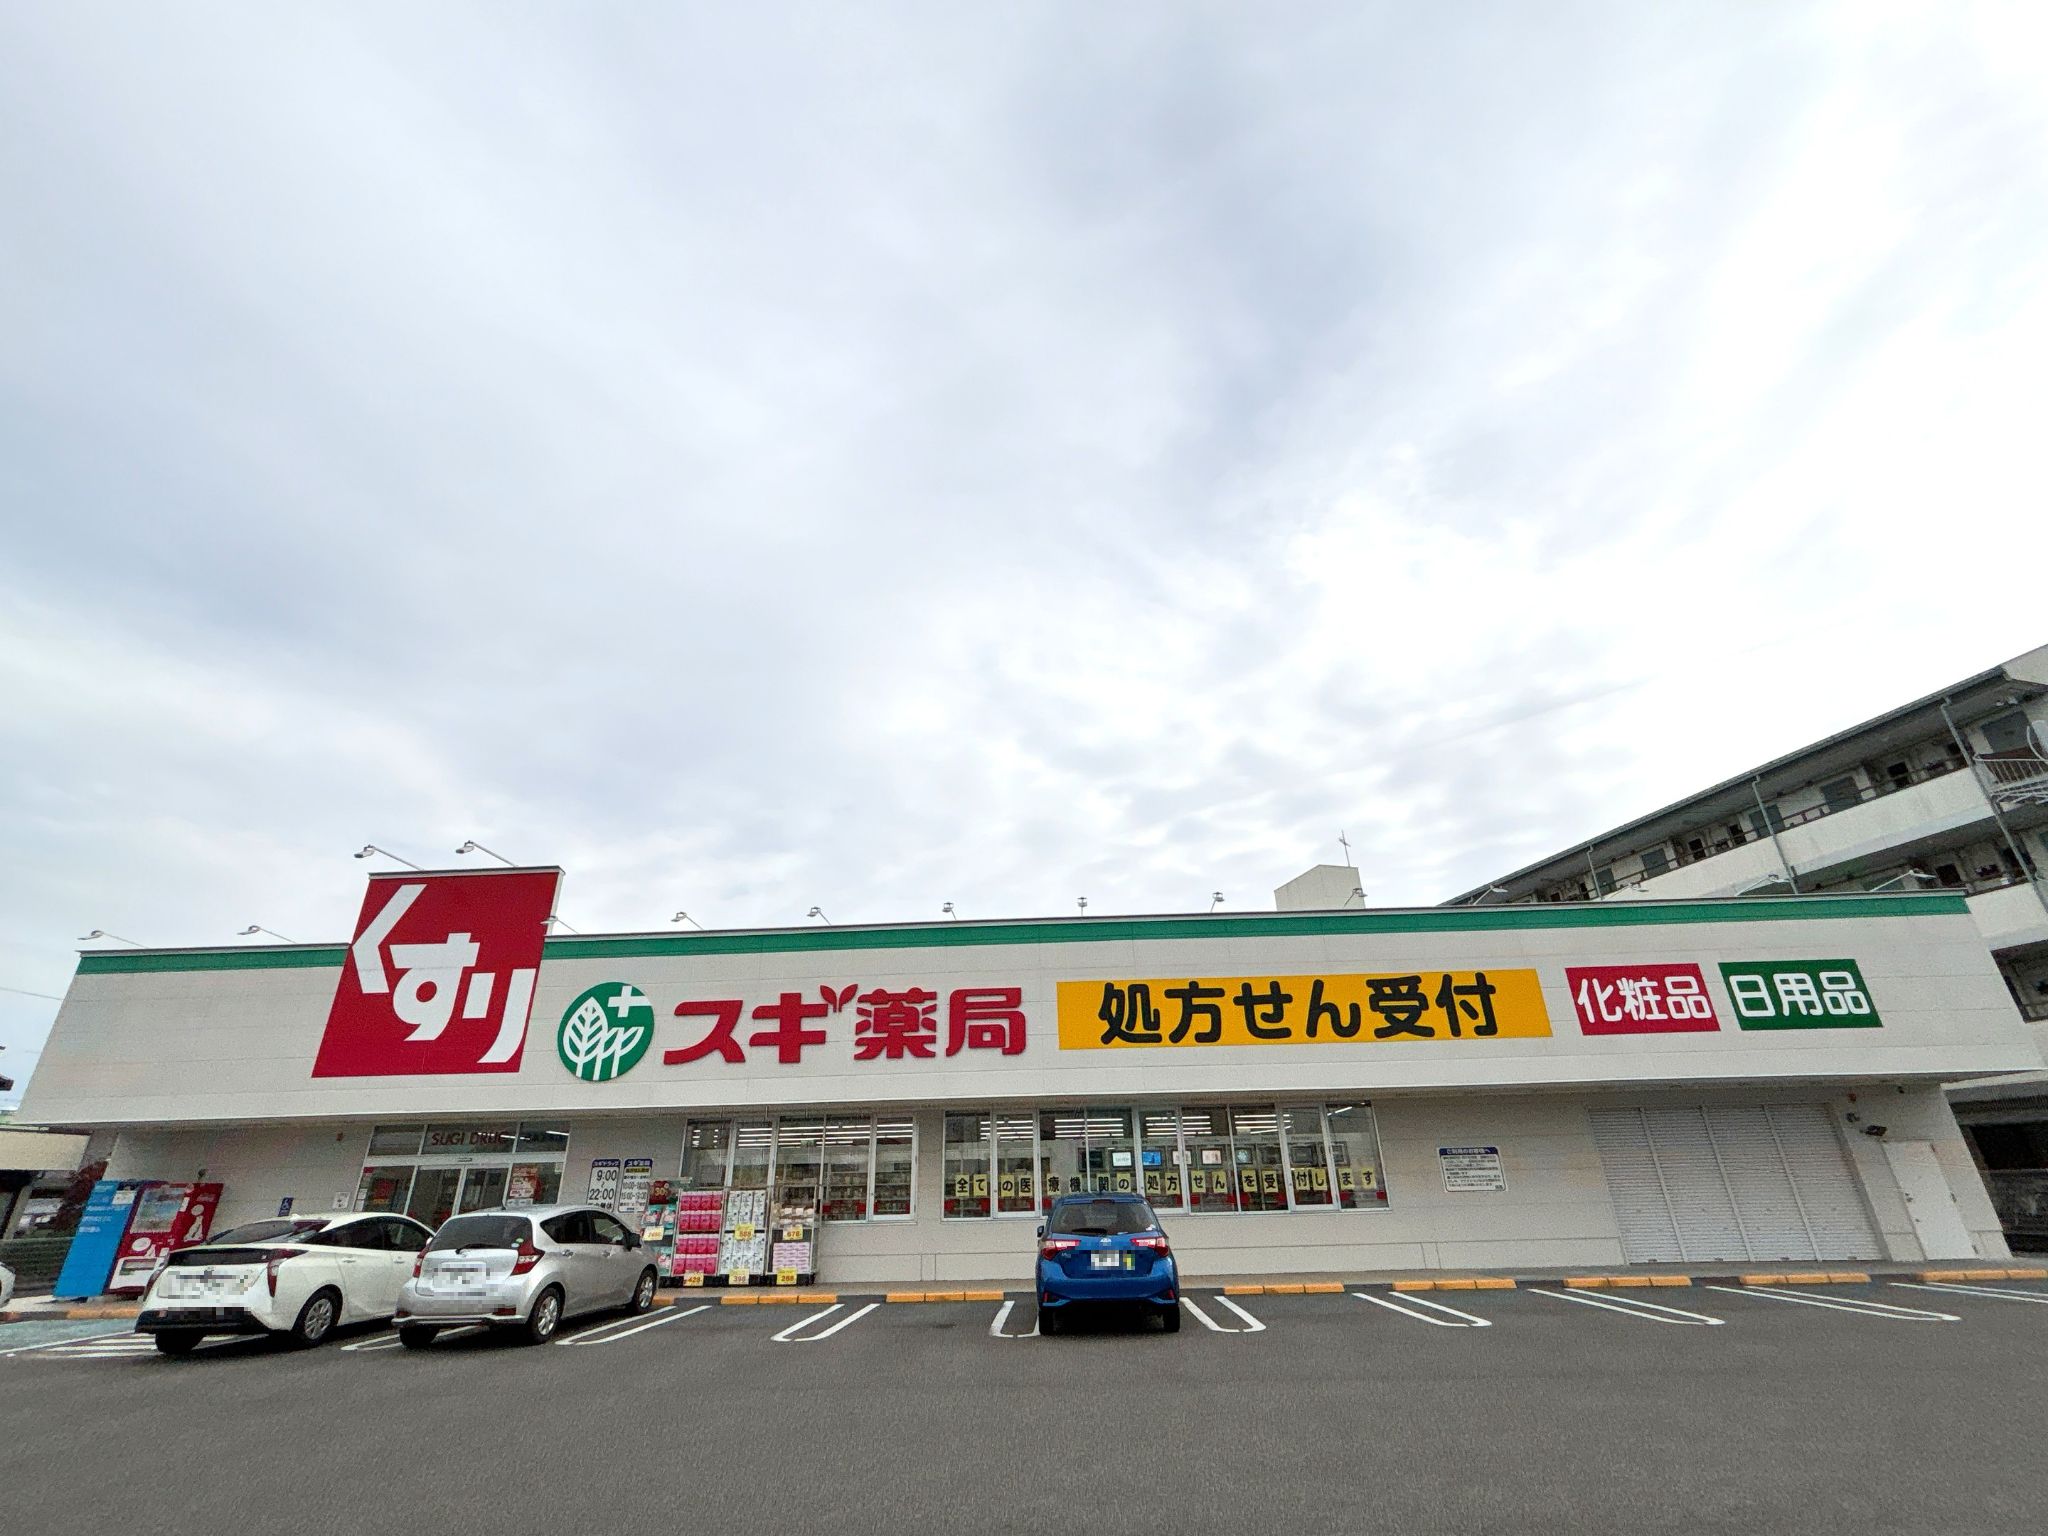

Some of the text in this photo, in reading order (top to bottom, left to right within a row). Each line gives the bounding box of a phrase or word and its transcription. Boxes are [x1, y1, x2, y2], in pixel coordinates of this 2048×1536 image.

[352, 884, 536, 1063] くすり
[1731, 971, 1872, 1018] 日用品
[1097, 972, 1498, 1045] 処方せん受付
[1577, 976, 1712, 1023] 化粧品
[663, 984, 1027, 1065] スギ薬局
[431, 1132, 465, 1146] SUGI
[589, 1188, 615, 1201] 22:00
[596, 1169, 618, 1181] 9:00
